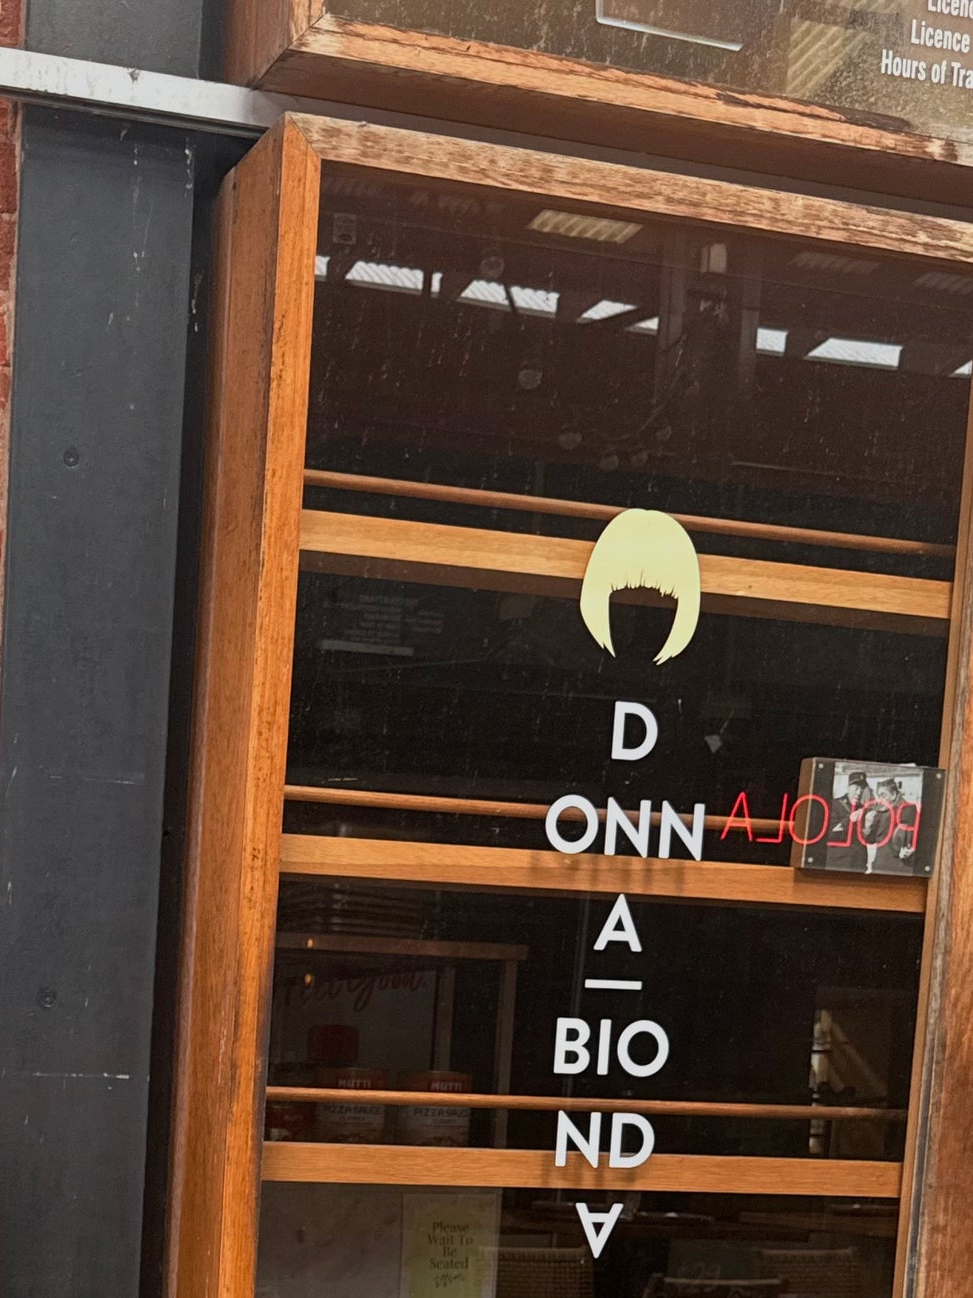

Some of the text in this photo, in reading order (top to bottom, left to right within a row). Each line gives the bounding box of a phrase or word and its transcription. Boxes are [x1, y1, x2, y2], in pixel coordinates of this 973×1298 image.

[911, 19, 970, 53] Licence
[881, 49, 926, 81] Hours
[931, 60, 947, 84] of
[611, 701, 658, 761] D
[545, 794, 706, 861] ONN
[593, 893, 643, 952] A
[553, 1017, 670, 1077] BIO
[555, 1110, 655, 1168] ND
[427, 1233, 474, 1246] Wait To
[432, 1220, 469, 1233] Please
[429, 1257, 469, 1270] Seated
[442, 1246, 458, 1258] Be
